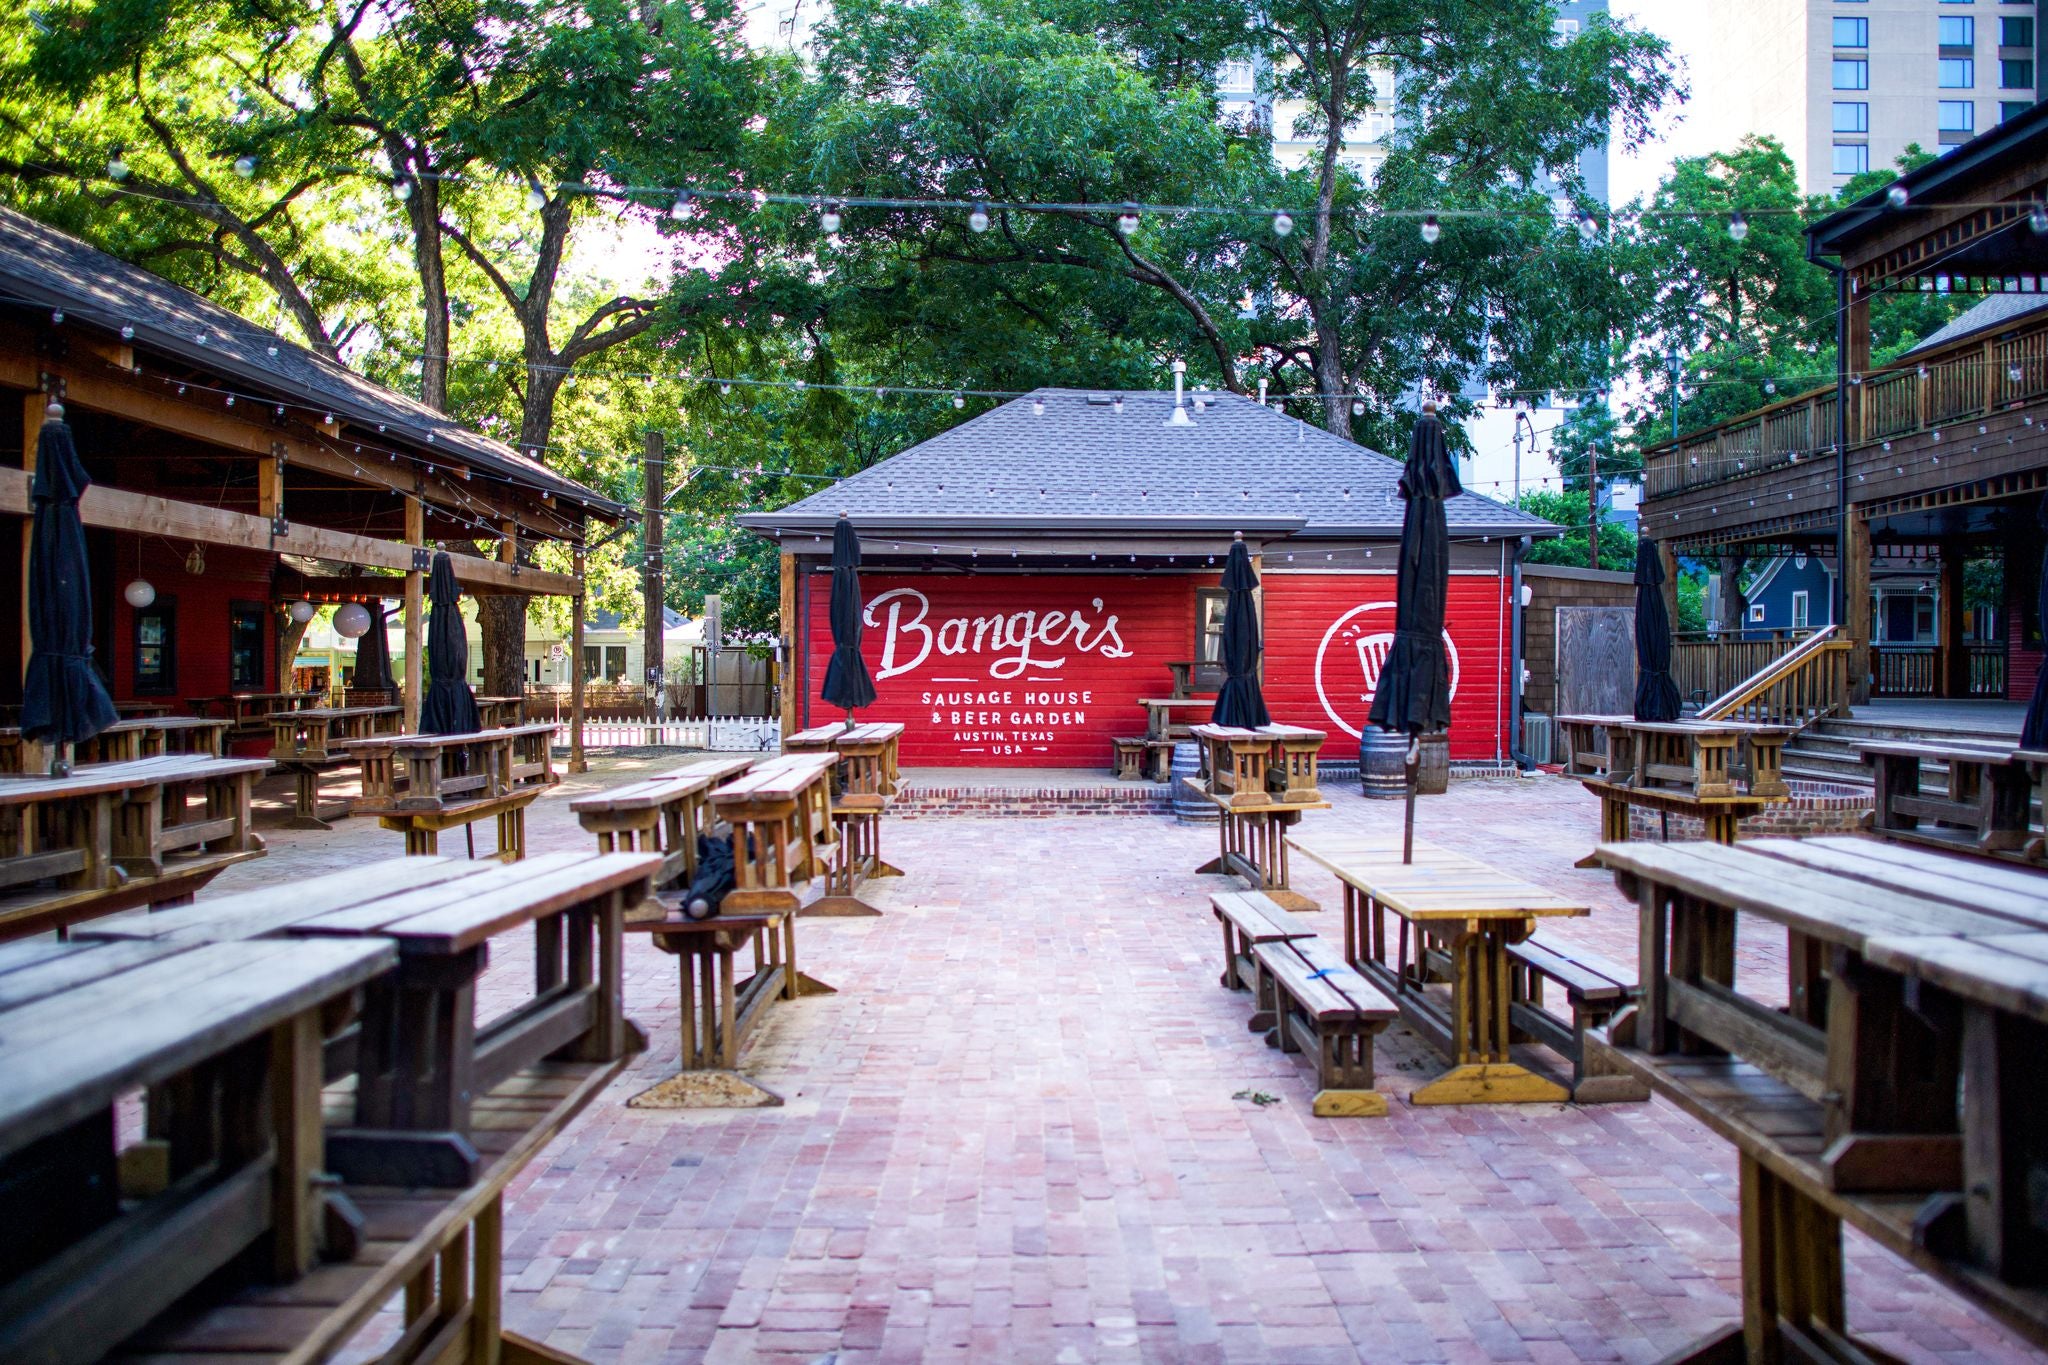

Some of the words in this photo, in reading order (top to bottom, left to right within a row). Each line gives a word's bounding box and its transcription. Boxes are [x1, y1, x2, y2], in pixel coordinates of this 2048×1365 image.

[862, 587, 1134, 680] Banger's
[921, 690, 1012, 706] SAUSAGE
[1025, 690, 1092, 706] HOUSE
[931, 711, 942, 724] &
[951, 711, 1001, 726] BEER
[1010, 711, 1085, 725] GARDEN
[1012, 731, 1054, 742] TEXAS
[992, 744, 1023, 755] USA
